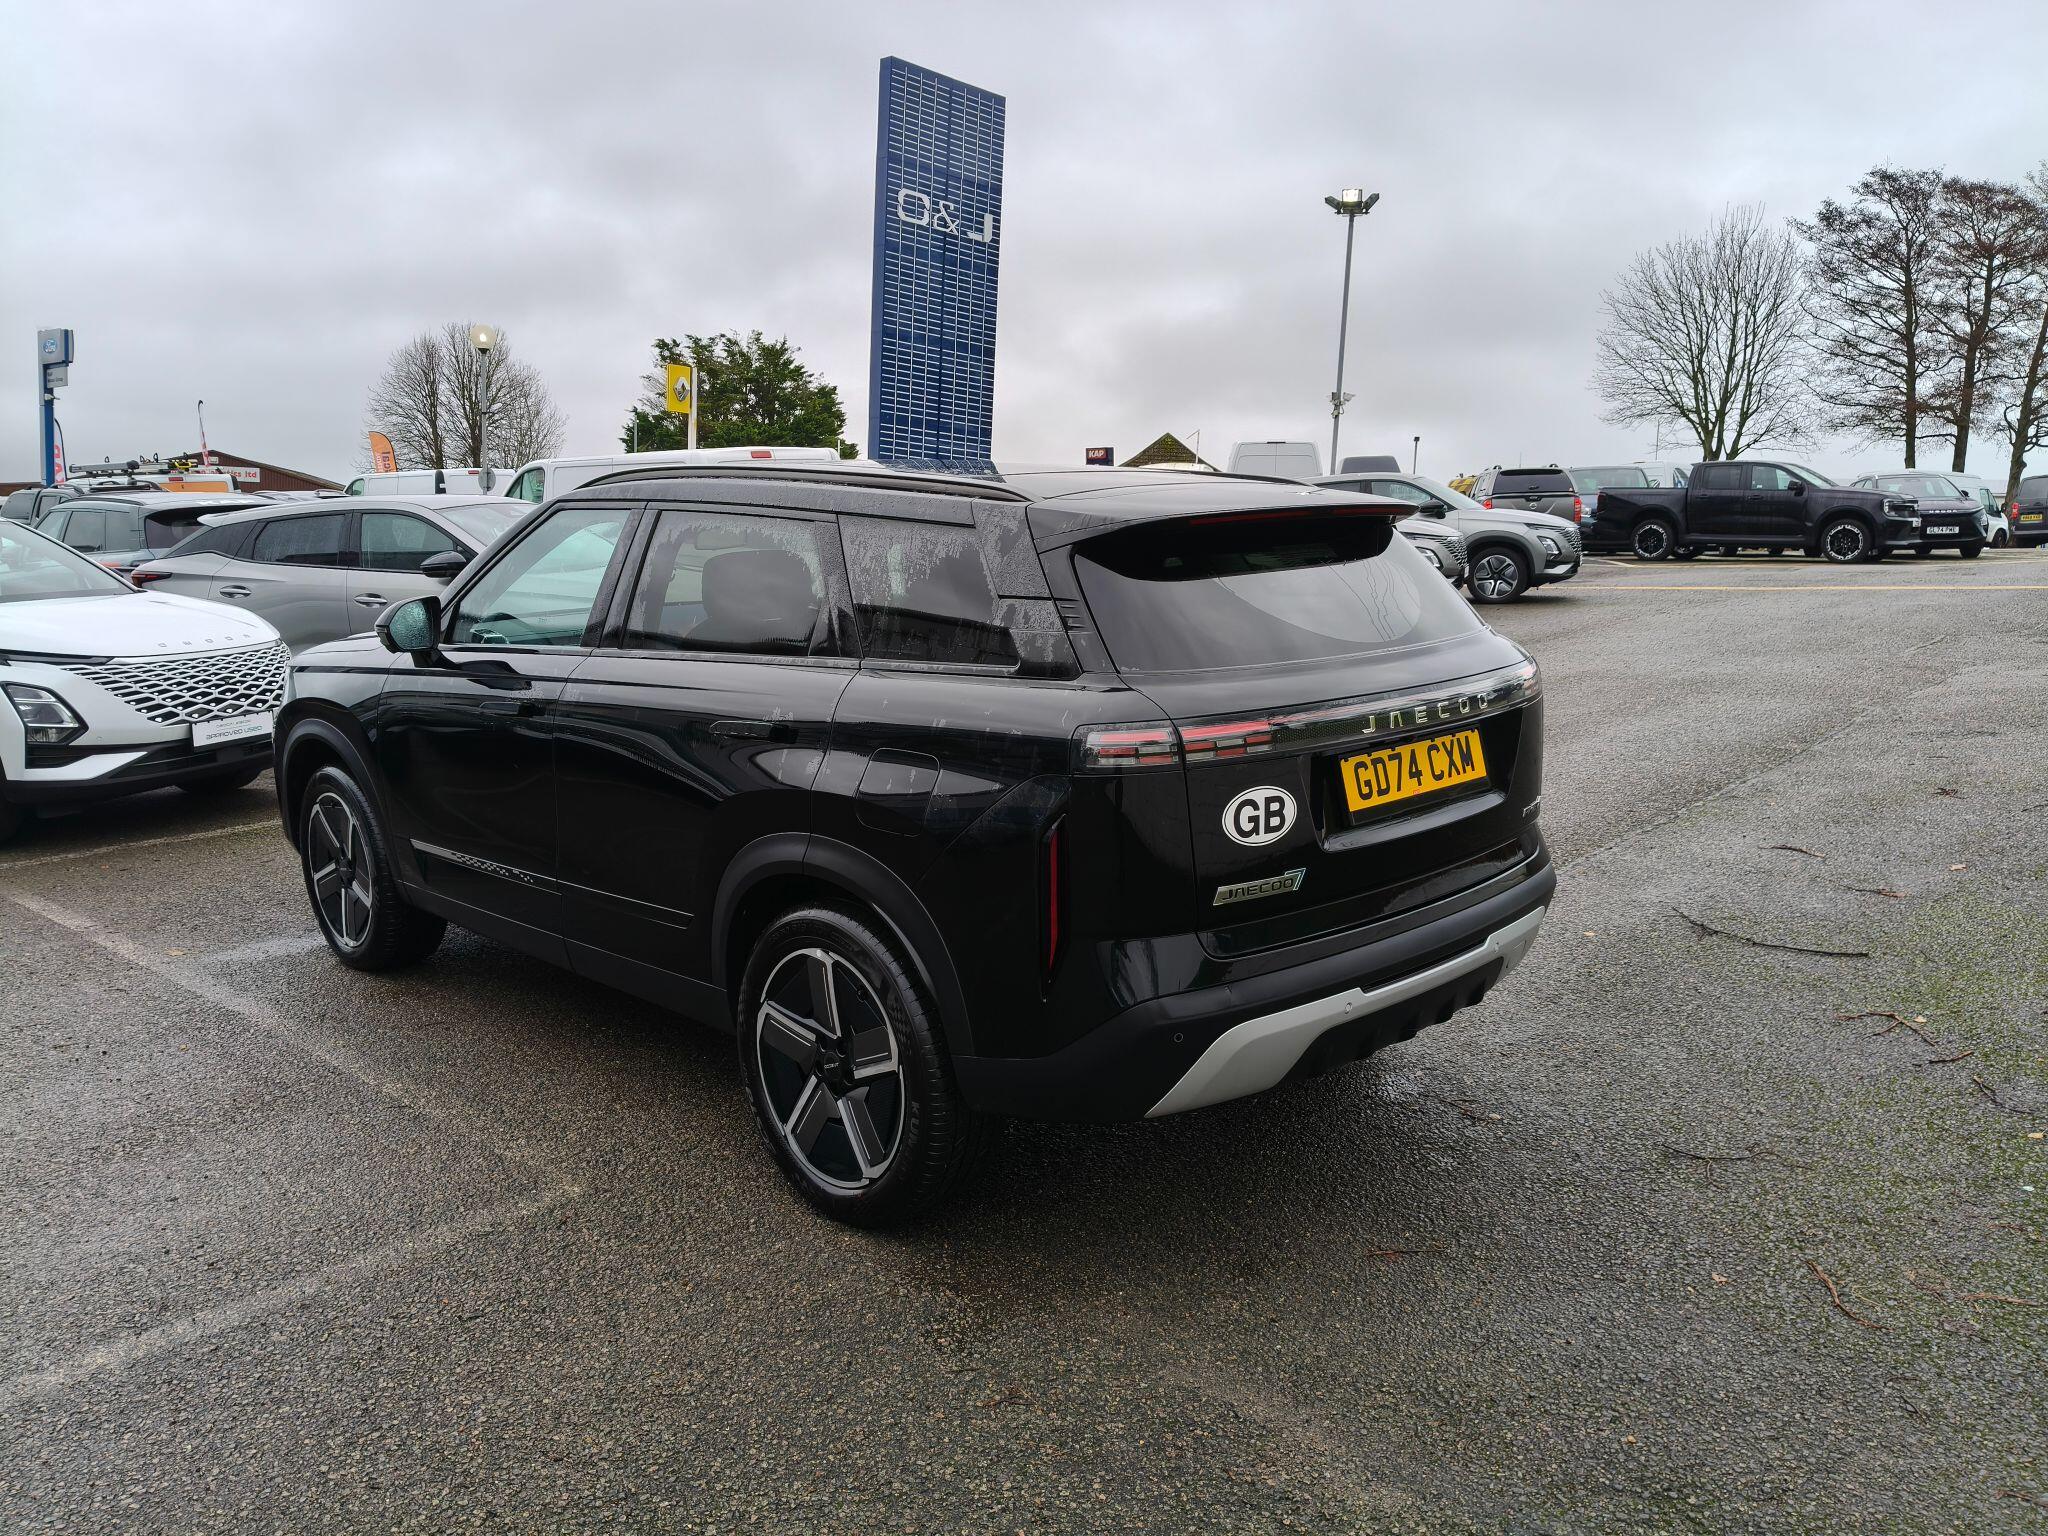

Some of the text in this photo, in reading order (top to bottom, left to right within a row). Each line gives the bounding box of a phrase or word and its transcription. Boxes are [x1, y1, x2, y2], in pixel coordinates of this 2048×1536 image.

[1362, 693, 1488, 733] JAECOO
[1354, 736, 1475, 801] GD74 CXM
[1234, 796, 1286, 838] GB
[1220, 879, 1293, 901] JAECOO
